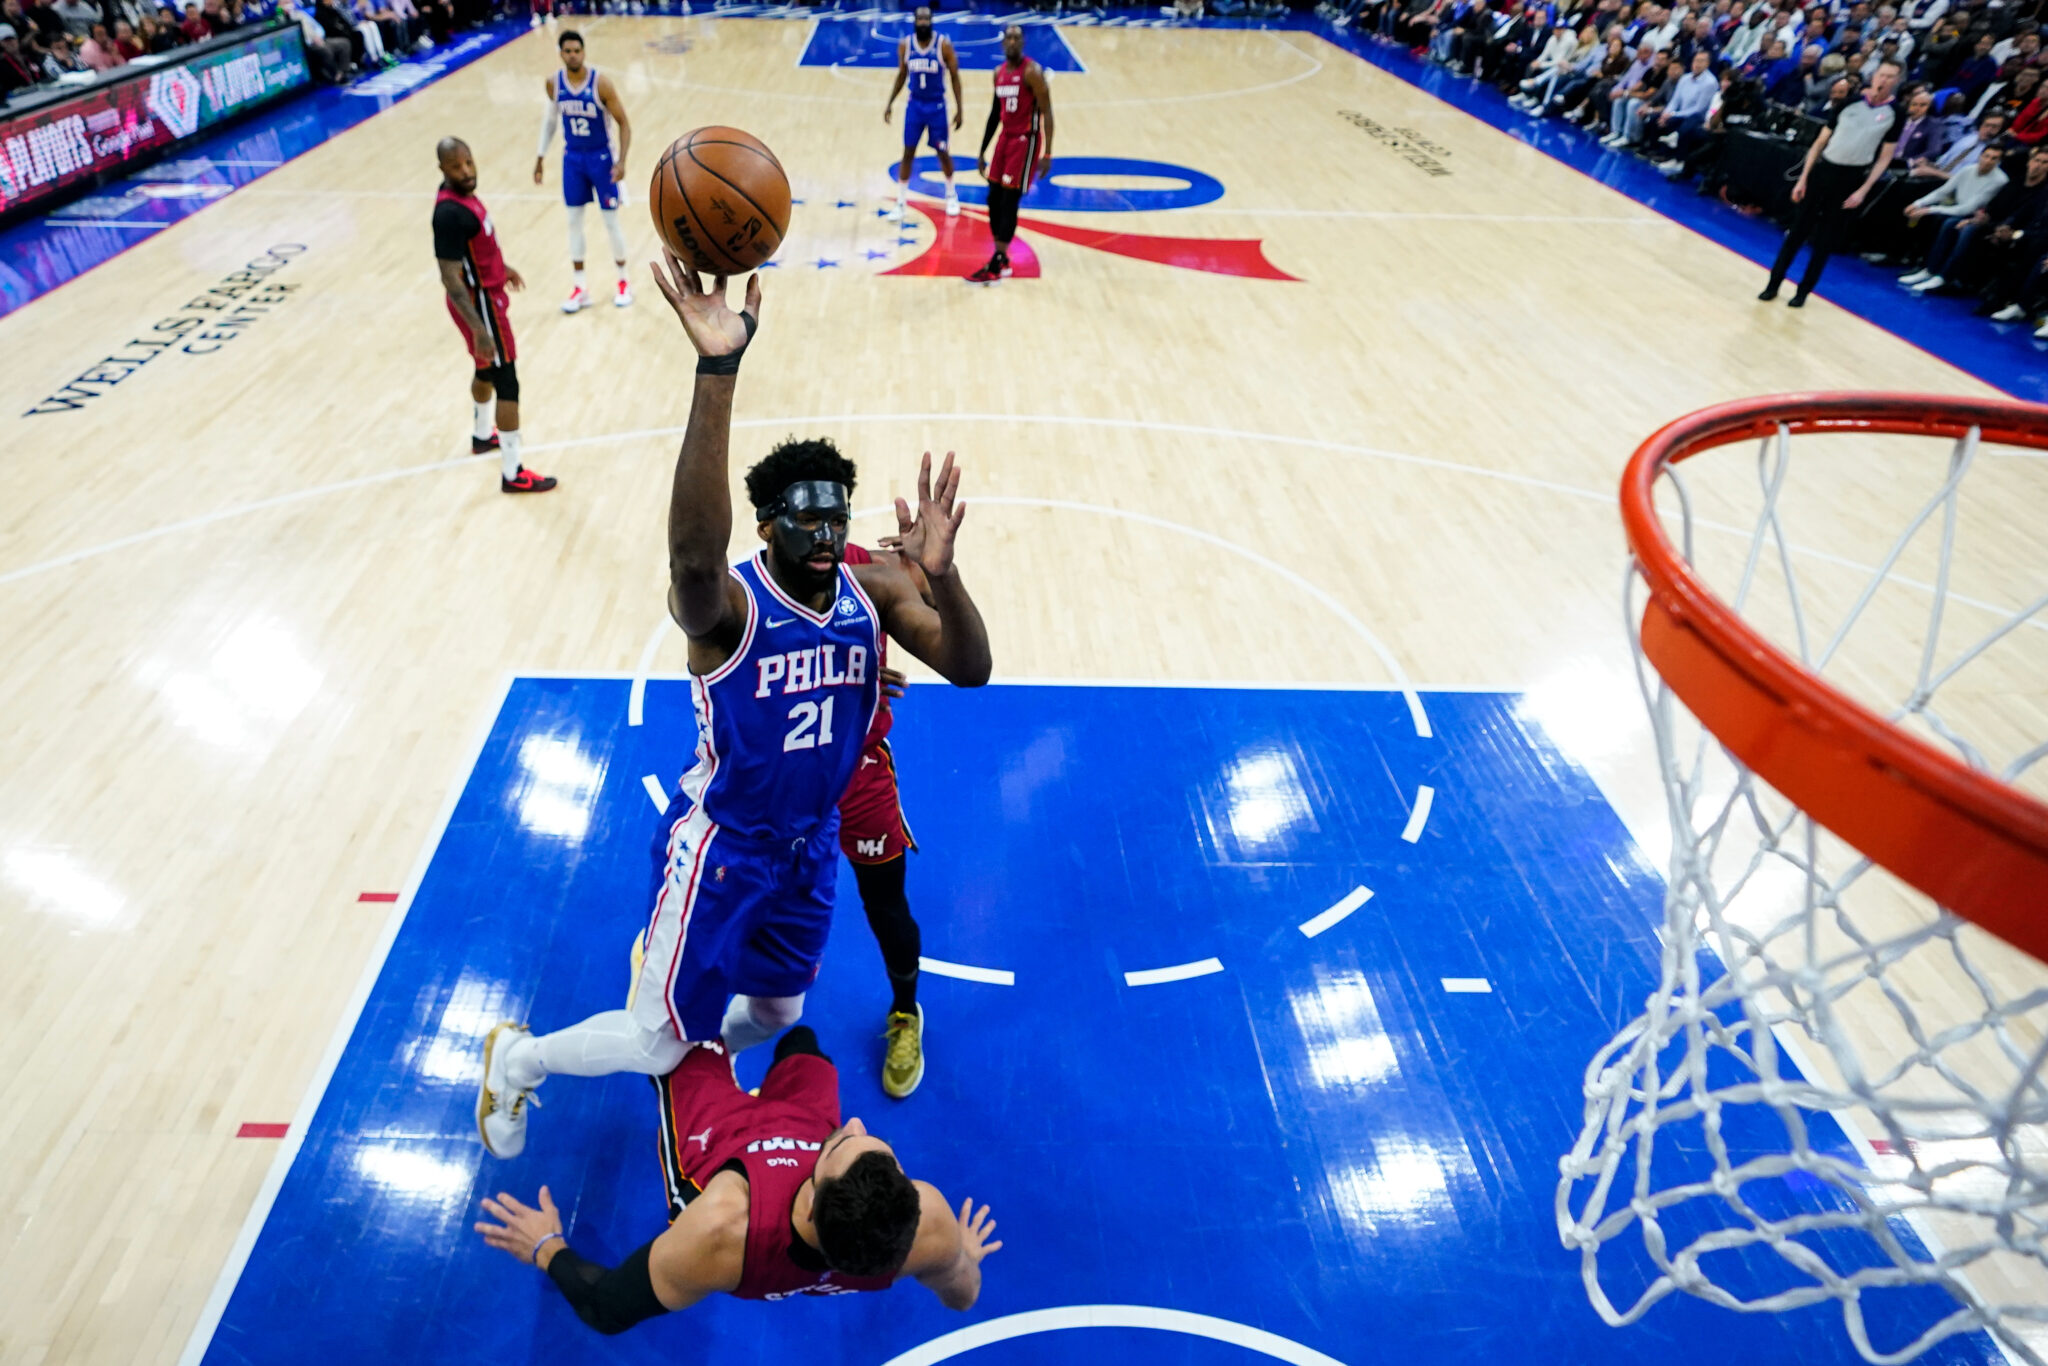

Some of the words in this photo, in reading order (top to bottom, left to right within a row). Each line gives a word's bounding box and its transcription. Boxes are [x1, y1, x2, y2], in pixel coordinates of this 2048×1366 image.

[907, 58, 939, 74] PHILA
[919, 73, 927, 89] 1
[569, 118, 590, 137] 12
[1005, 97, 1018, 112] 13
[5, 113, 93, 192] PLAYOFFS
[21, 316, 204, 418] WELLS
[179, 243, 308, 312] FARGO
[182, 283, 303, 355] CENTER
[755, 644, 867, 698] PHILA
[783, 695, 835, 752] 21
